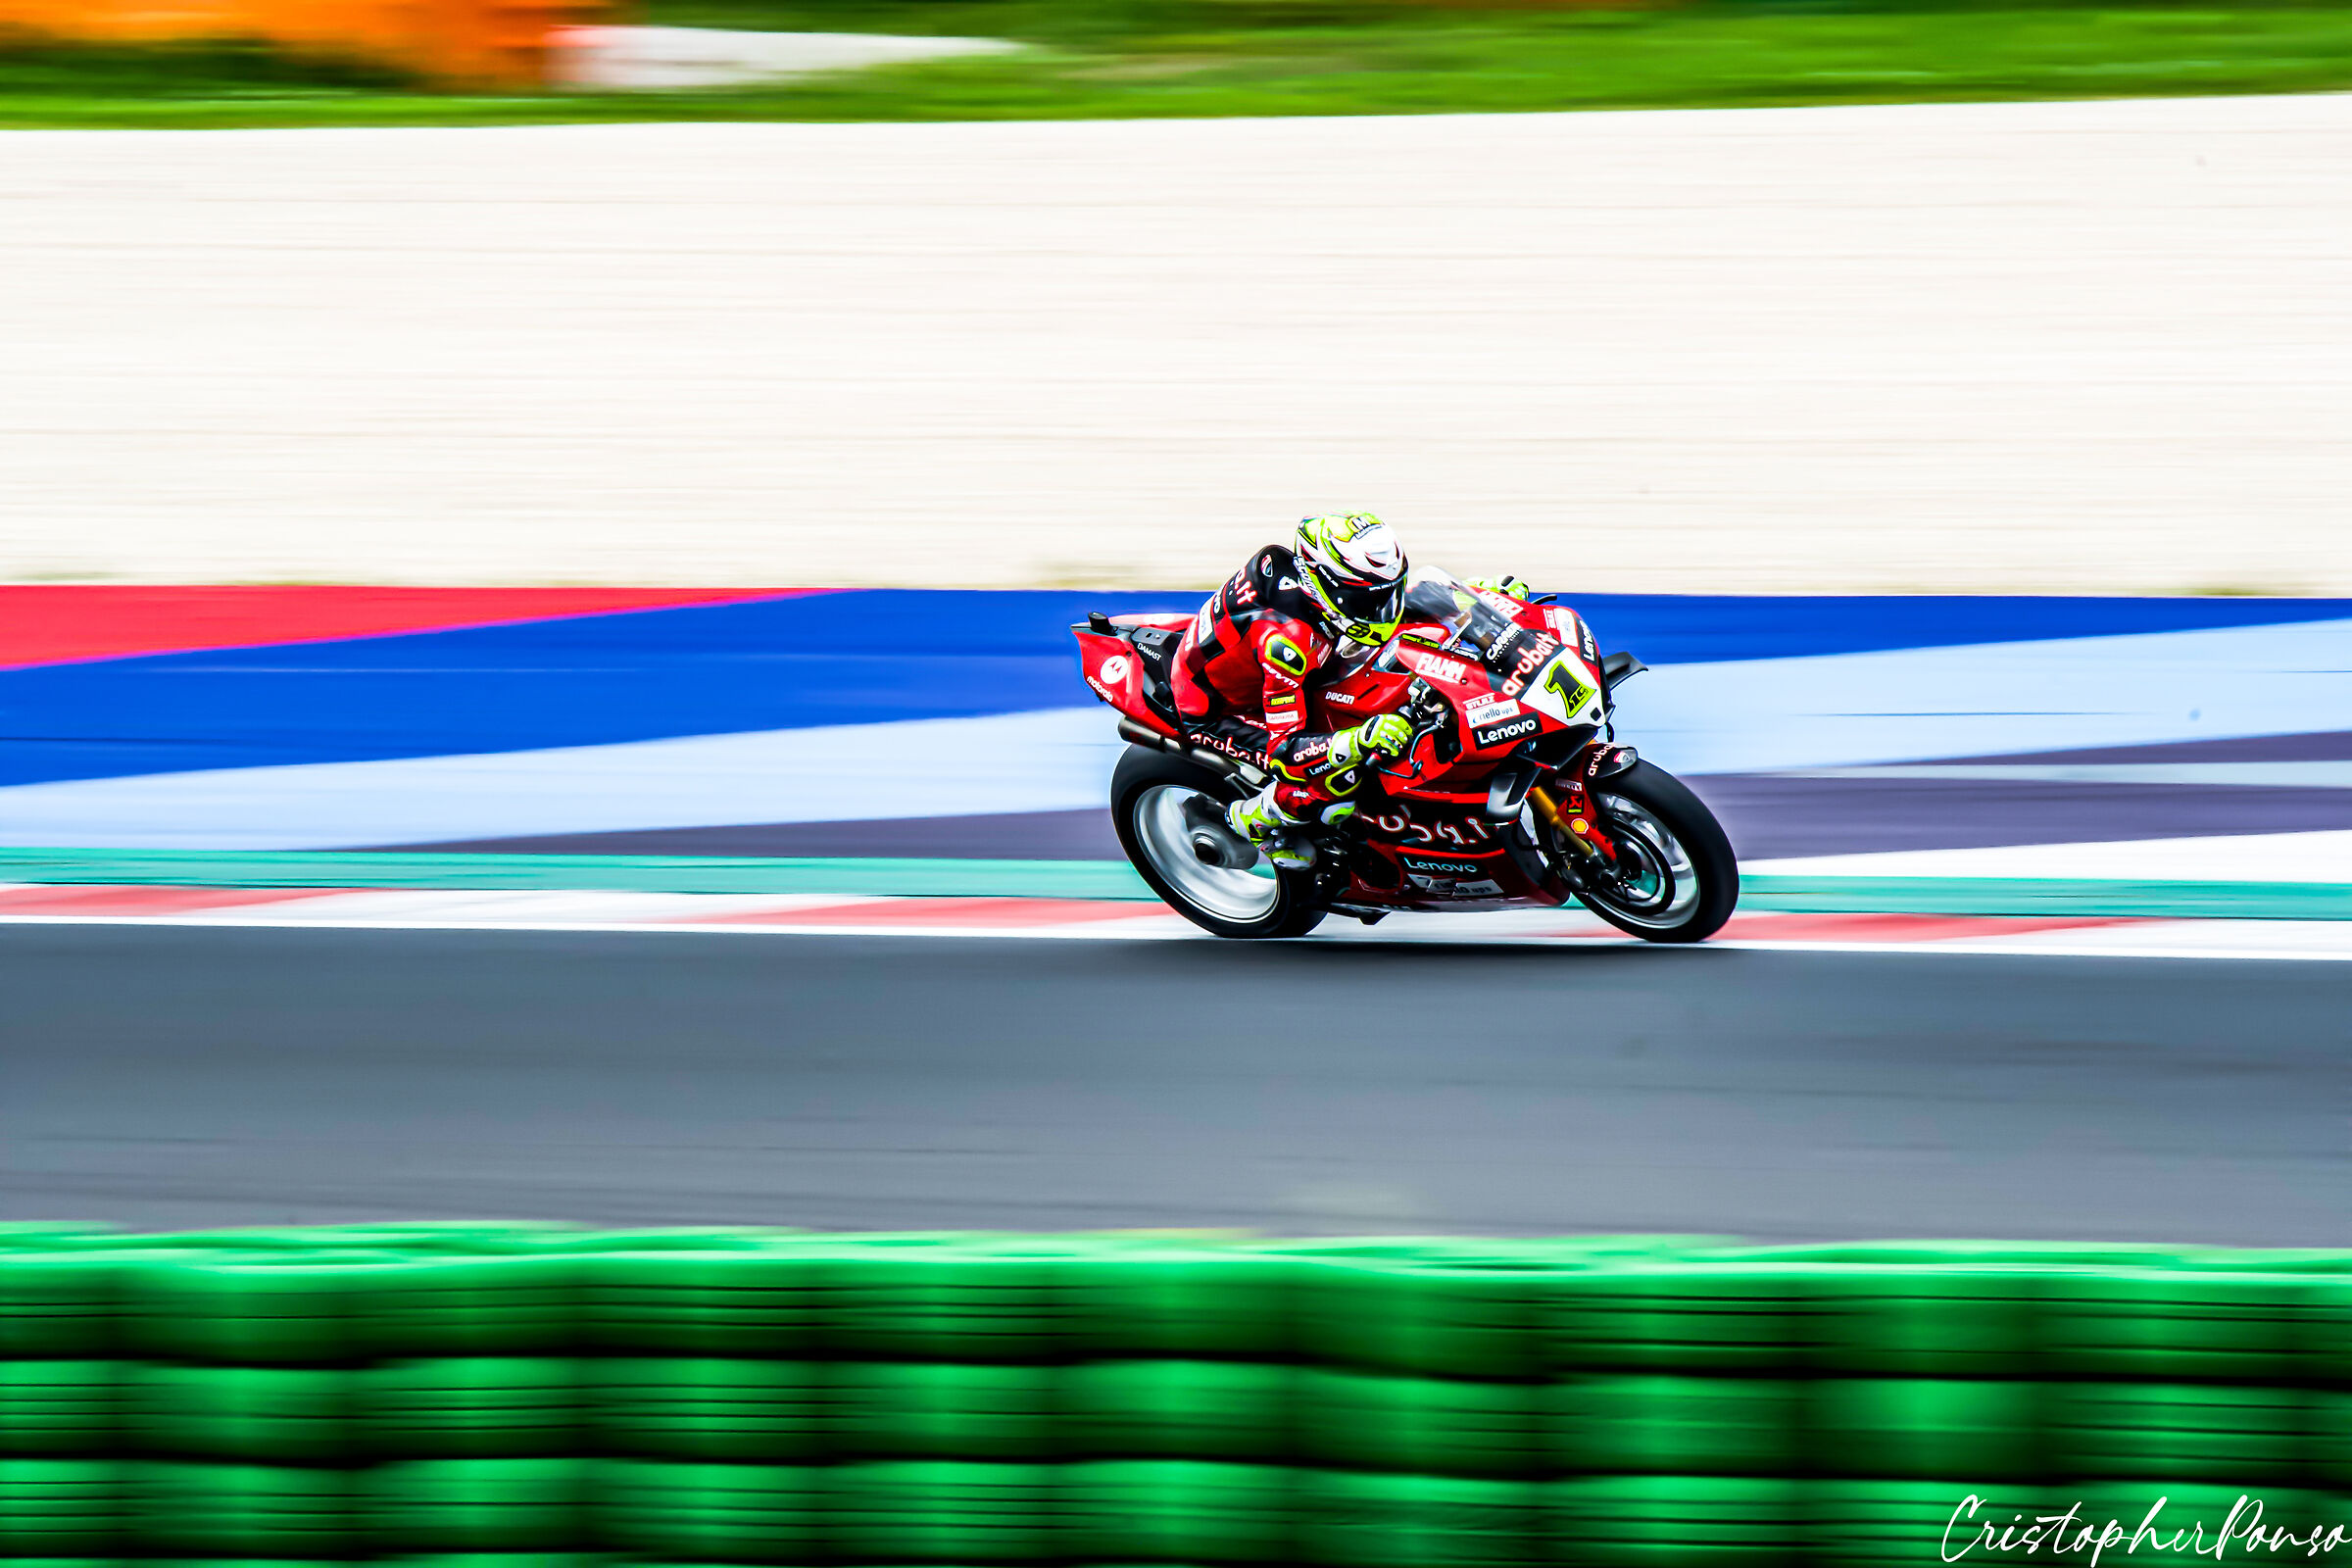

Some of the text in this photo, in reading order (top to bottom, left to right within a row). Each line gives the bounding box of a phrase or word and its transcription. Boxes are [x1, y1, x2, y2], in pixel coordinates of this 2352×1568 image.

[1416, 652, 1467, 681] FIAMM
[1087, 675, 1113, 703] motorola
[1325, 691, 1355, 706] DUCATI
[1544, 660, 1597, 719] 1
[1477, 719, 1537, 745] Lenovo
[1308, 762, 1332, 776] Leno
[1403, 857, 1478, 873] Lenovo
